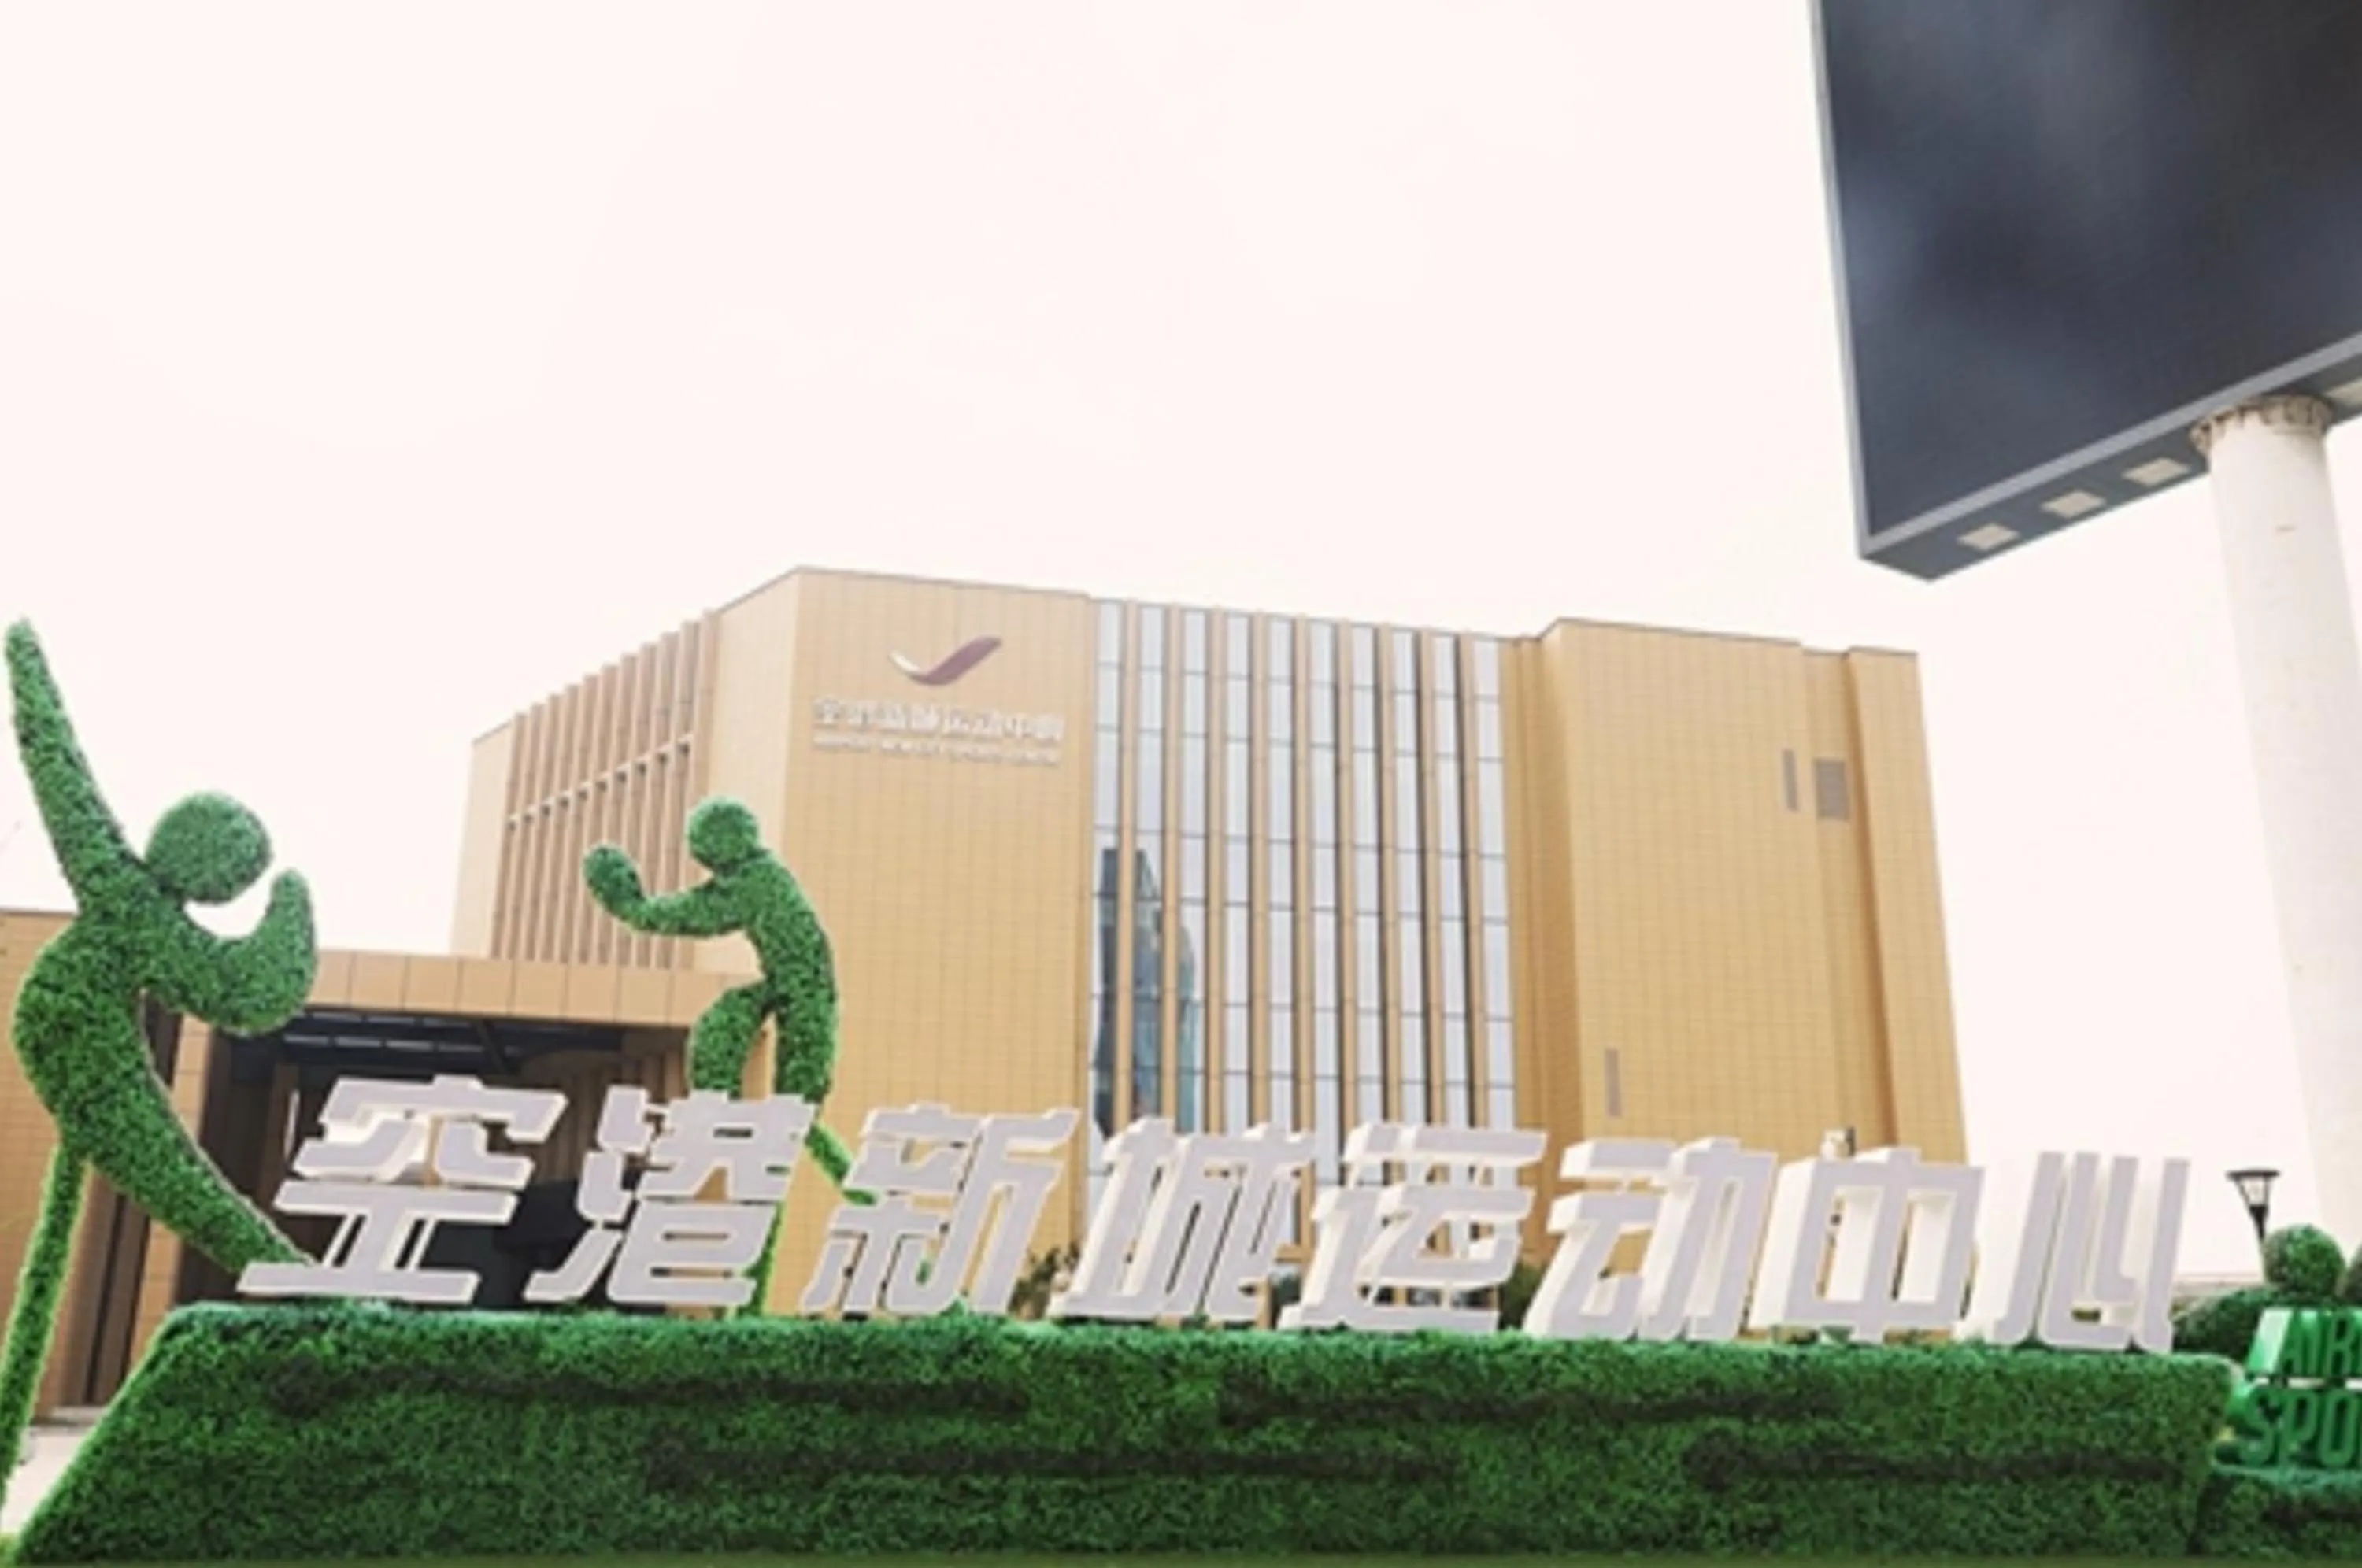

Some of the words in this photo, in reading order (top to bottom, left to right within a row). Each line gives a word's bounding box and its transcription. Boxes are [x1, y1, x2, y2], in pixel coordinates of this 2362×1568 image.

[239, 1074, 2191, 1352] 空港新城运动中心
[2248, 1307, 2362, 1376] AIR
[2236, 1386, 2362, 1467] SPO
